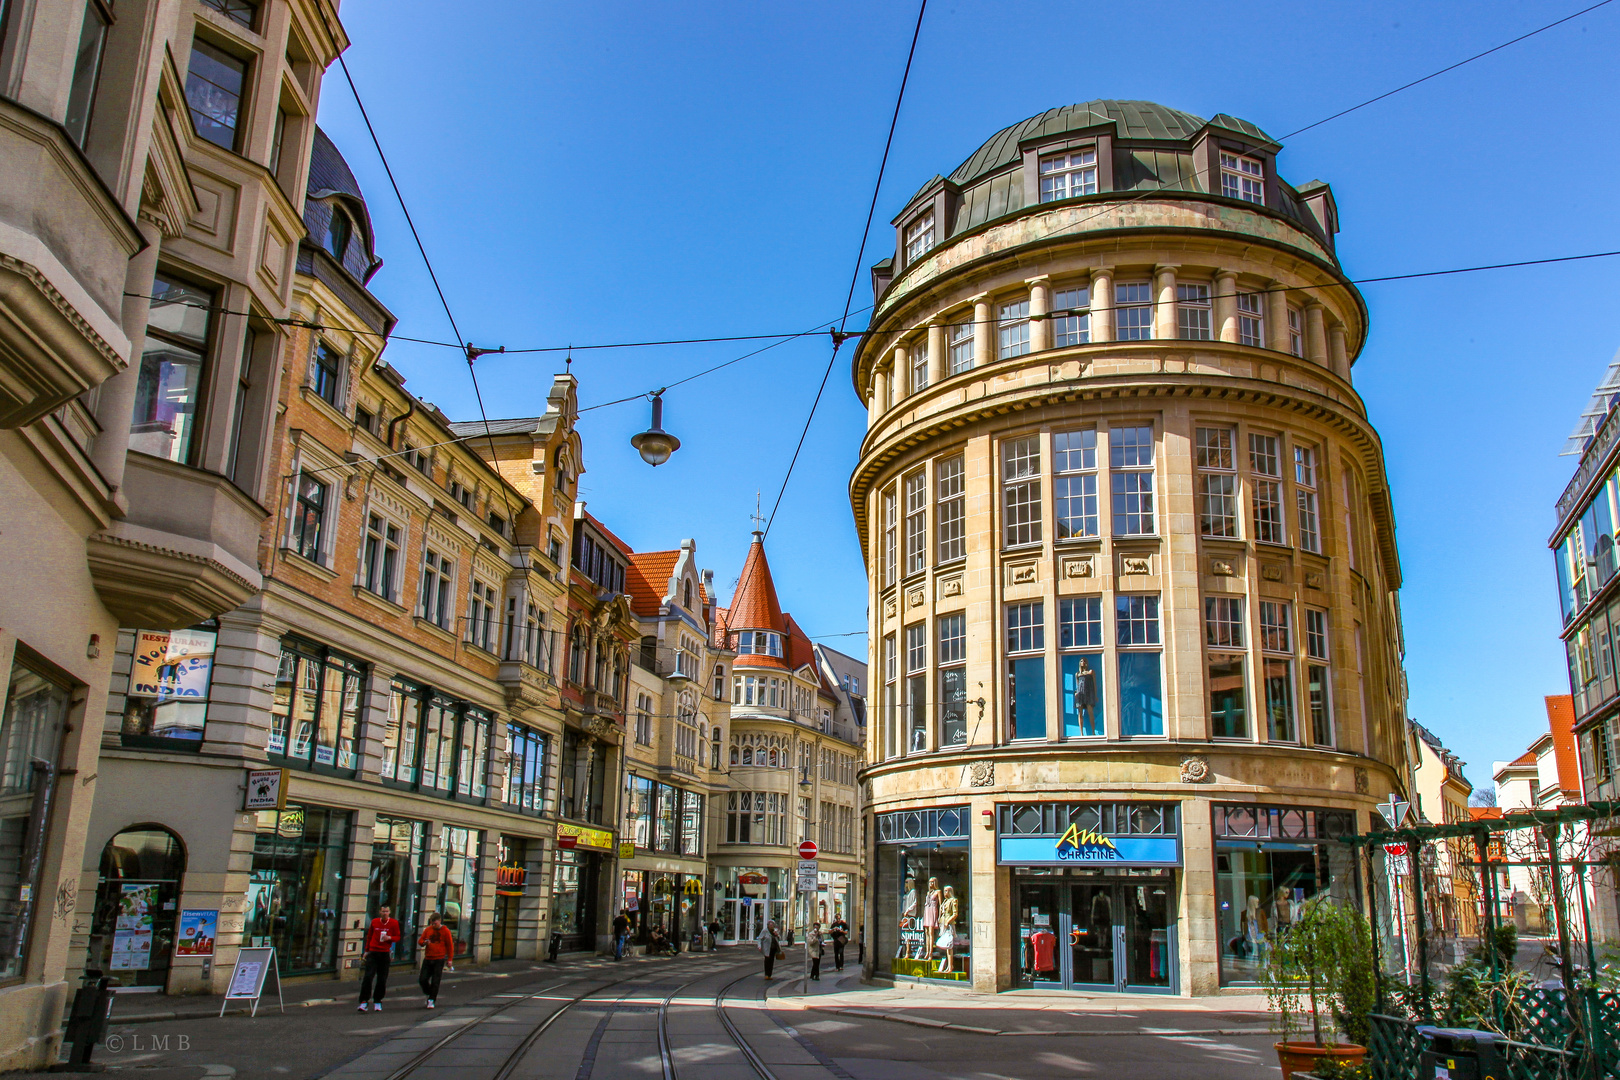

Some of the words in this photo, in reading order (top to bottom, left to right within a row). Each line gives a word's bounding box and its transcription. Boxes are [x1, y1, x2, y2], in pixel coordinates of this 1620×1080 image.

[142, 634, 209, 647] RESTAURANT
[136, 645, 189, 666] House
[136, 683, 200, 697] INDIA
[251, 776, 270, 786] House
[1055, 823, 1116, 849] Ann
[1057, 848, 1115, 860] CHRISTINE
[901, 917, 925, 931] 2011
[901, 931, 925, 943] spring
